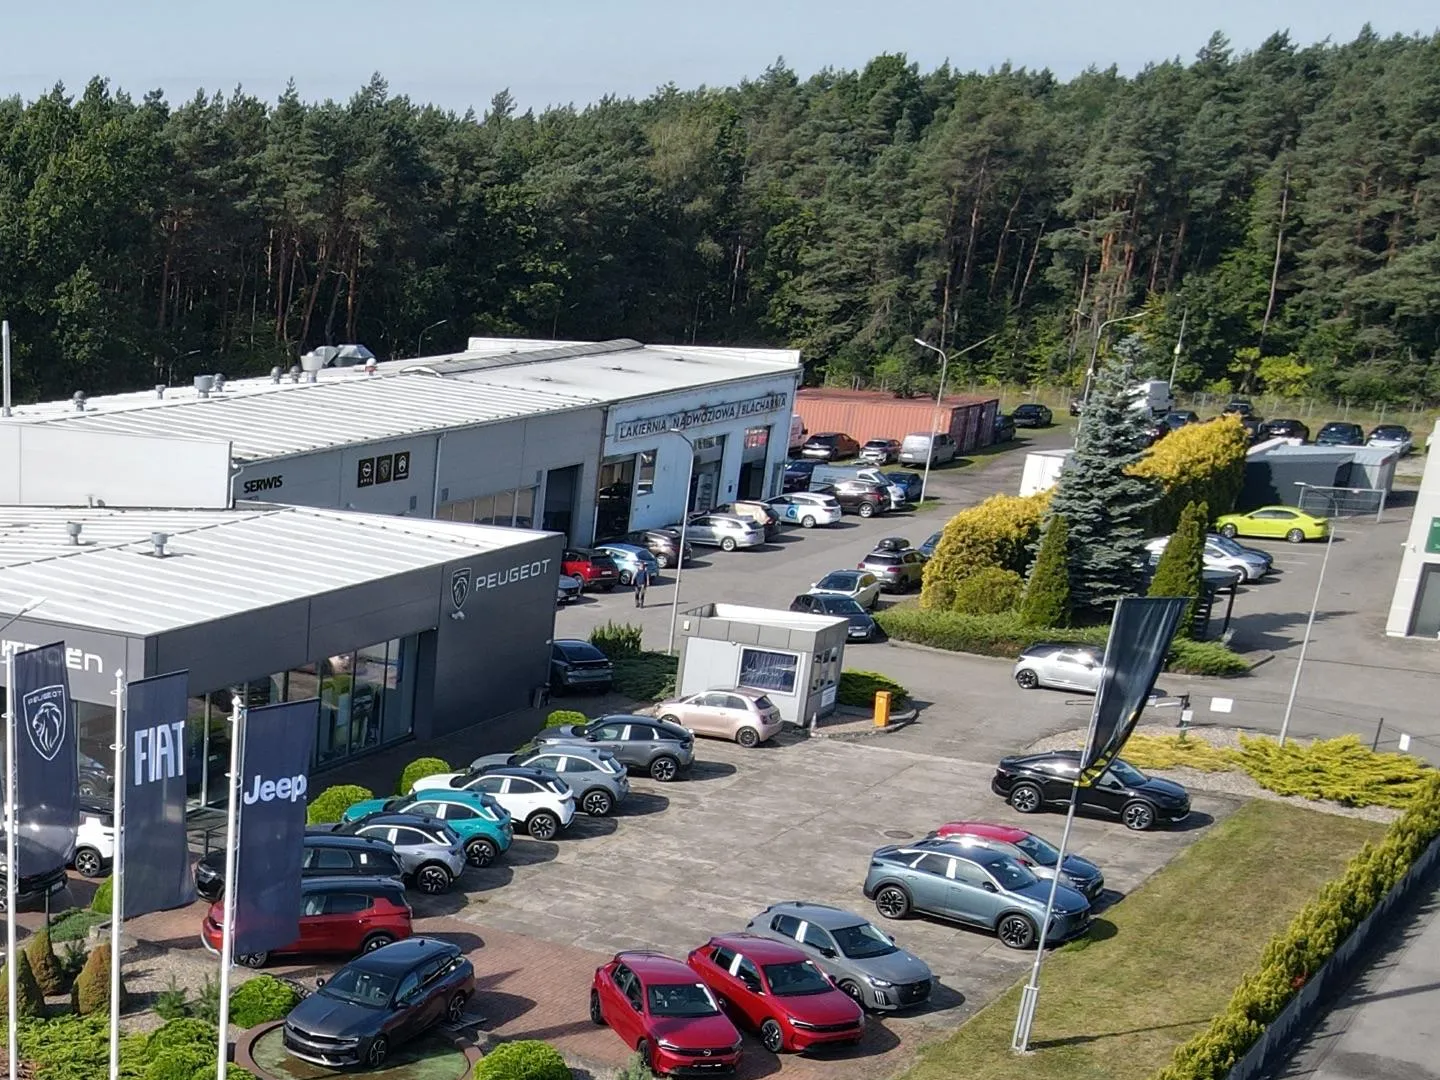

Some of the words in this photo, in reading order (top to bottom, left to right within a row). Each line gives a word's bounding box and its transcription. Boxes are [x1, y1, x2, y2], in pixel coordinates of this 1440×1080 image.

[620, 420, 667, 438] LAKIERNIA
[673, 406, 735, 428] NADWOZIOWA
[243, 475, 283, 493] SERWIS
[476, 559, 551, 591] PEUGEOT
[134, 720, 185, 786] FIAT
[244, 774, 307, 805] Jeep
